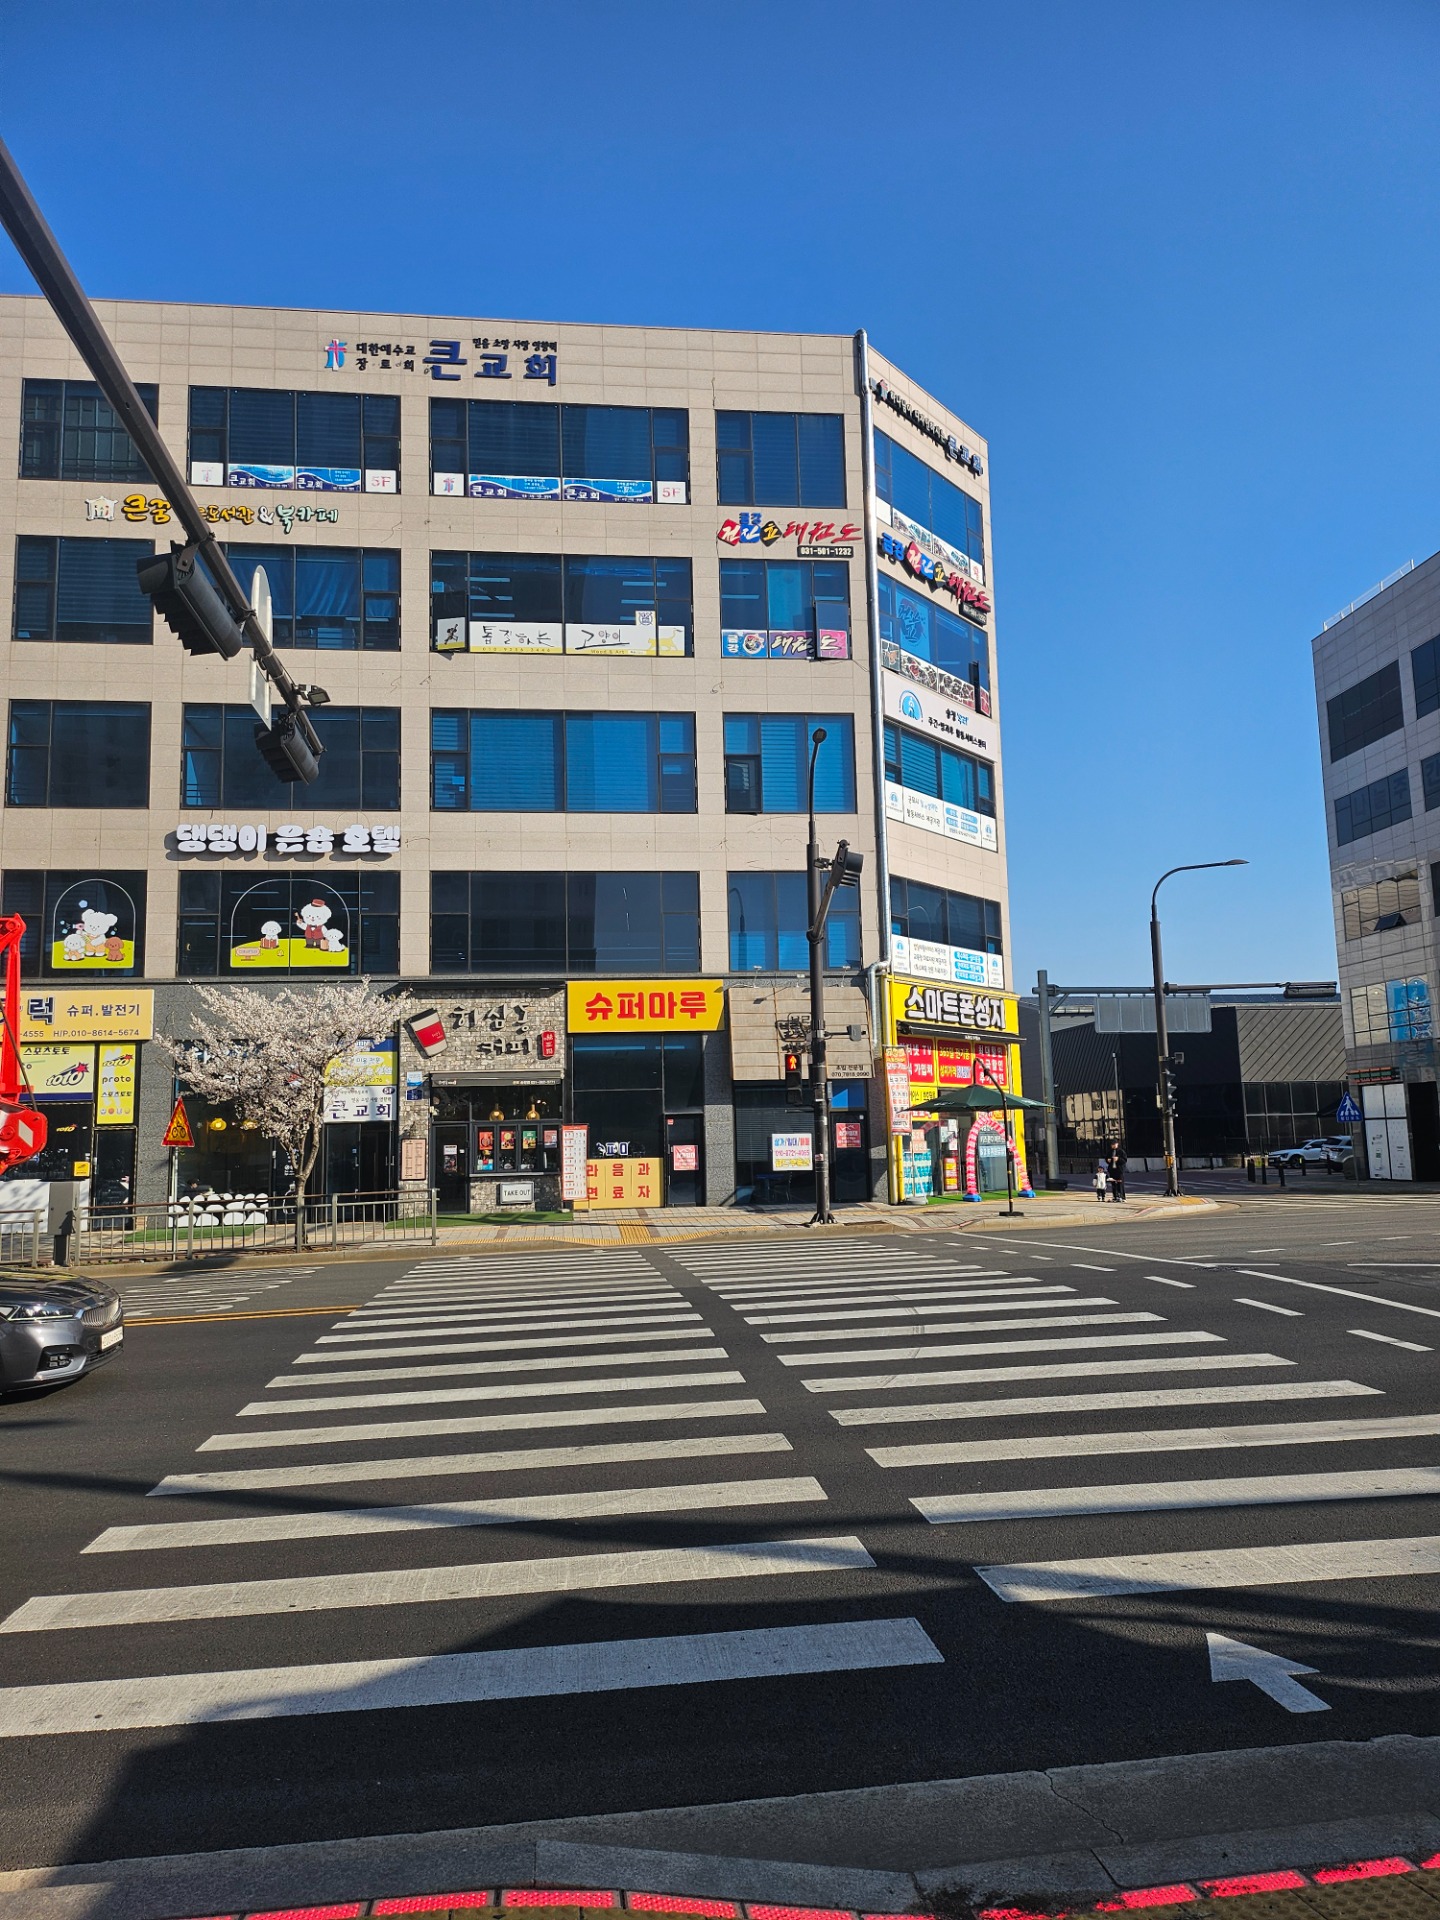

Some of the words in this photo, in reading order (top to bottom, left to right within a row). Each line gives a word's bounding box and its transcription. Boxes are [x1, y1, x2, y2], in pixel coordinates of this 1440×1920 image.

[355, 342, 416, 357] 대한예수교
[473, 337, 490, 350] 믿음
[492, 338, 510, 351] 소망
[513, 339, 530, 352] 사랑
[531, 340, 558, 353] 영향력
[230, 474, 256, 487] 큰교회
[297, 477, 323, 490] 큰교회
[370, 476, 390, 488] 5F
[470, 484, 508, 498] 큰교회
[565, 487, 600, 501] 큰교회
[662, 487, 681, 498] 5F
[258, 507, 275, 525] &
[276, 504, 339, 534] 북카페
[781, 520, 863, 545] 태권도
[948, 572, 991, 613] 태권도
[771, 634, 842, 656] 태권도
[176, 823, 267, 853] 댕댕이
[342, 823, 401, 854] 호텔
[585, 991, 707, 1021] 슈퍼마루
[905, 985, 1006, 1029] 스마트폰성지
[452, 1003, 530, 1032] 하삼동
[23, 1046, 70, 1056] 스포츠토토
[482, 1038, 533, 1053] 커피
[101, 1075, 132, 1085] proto
